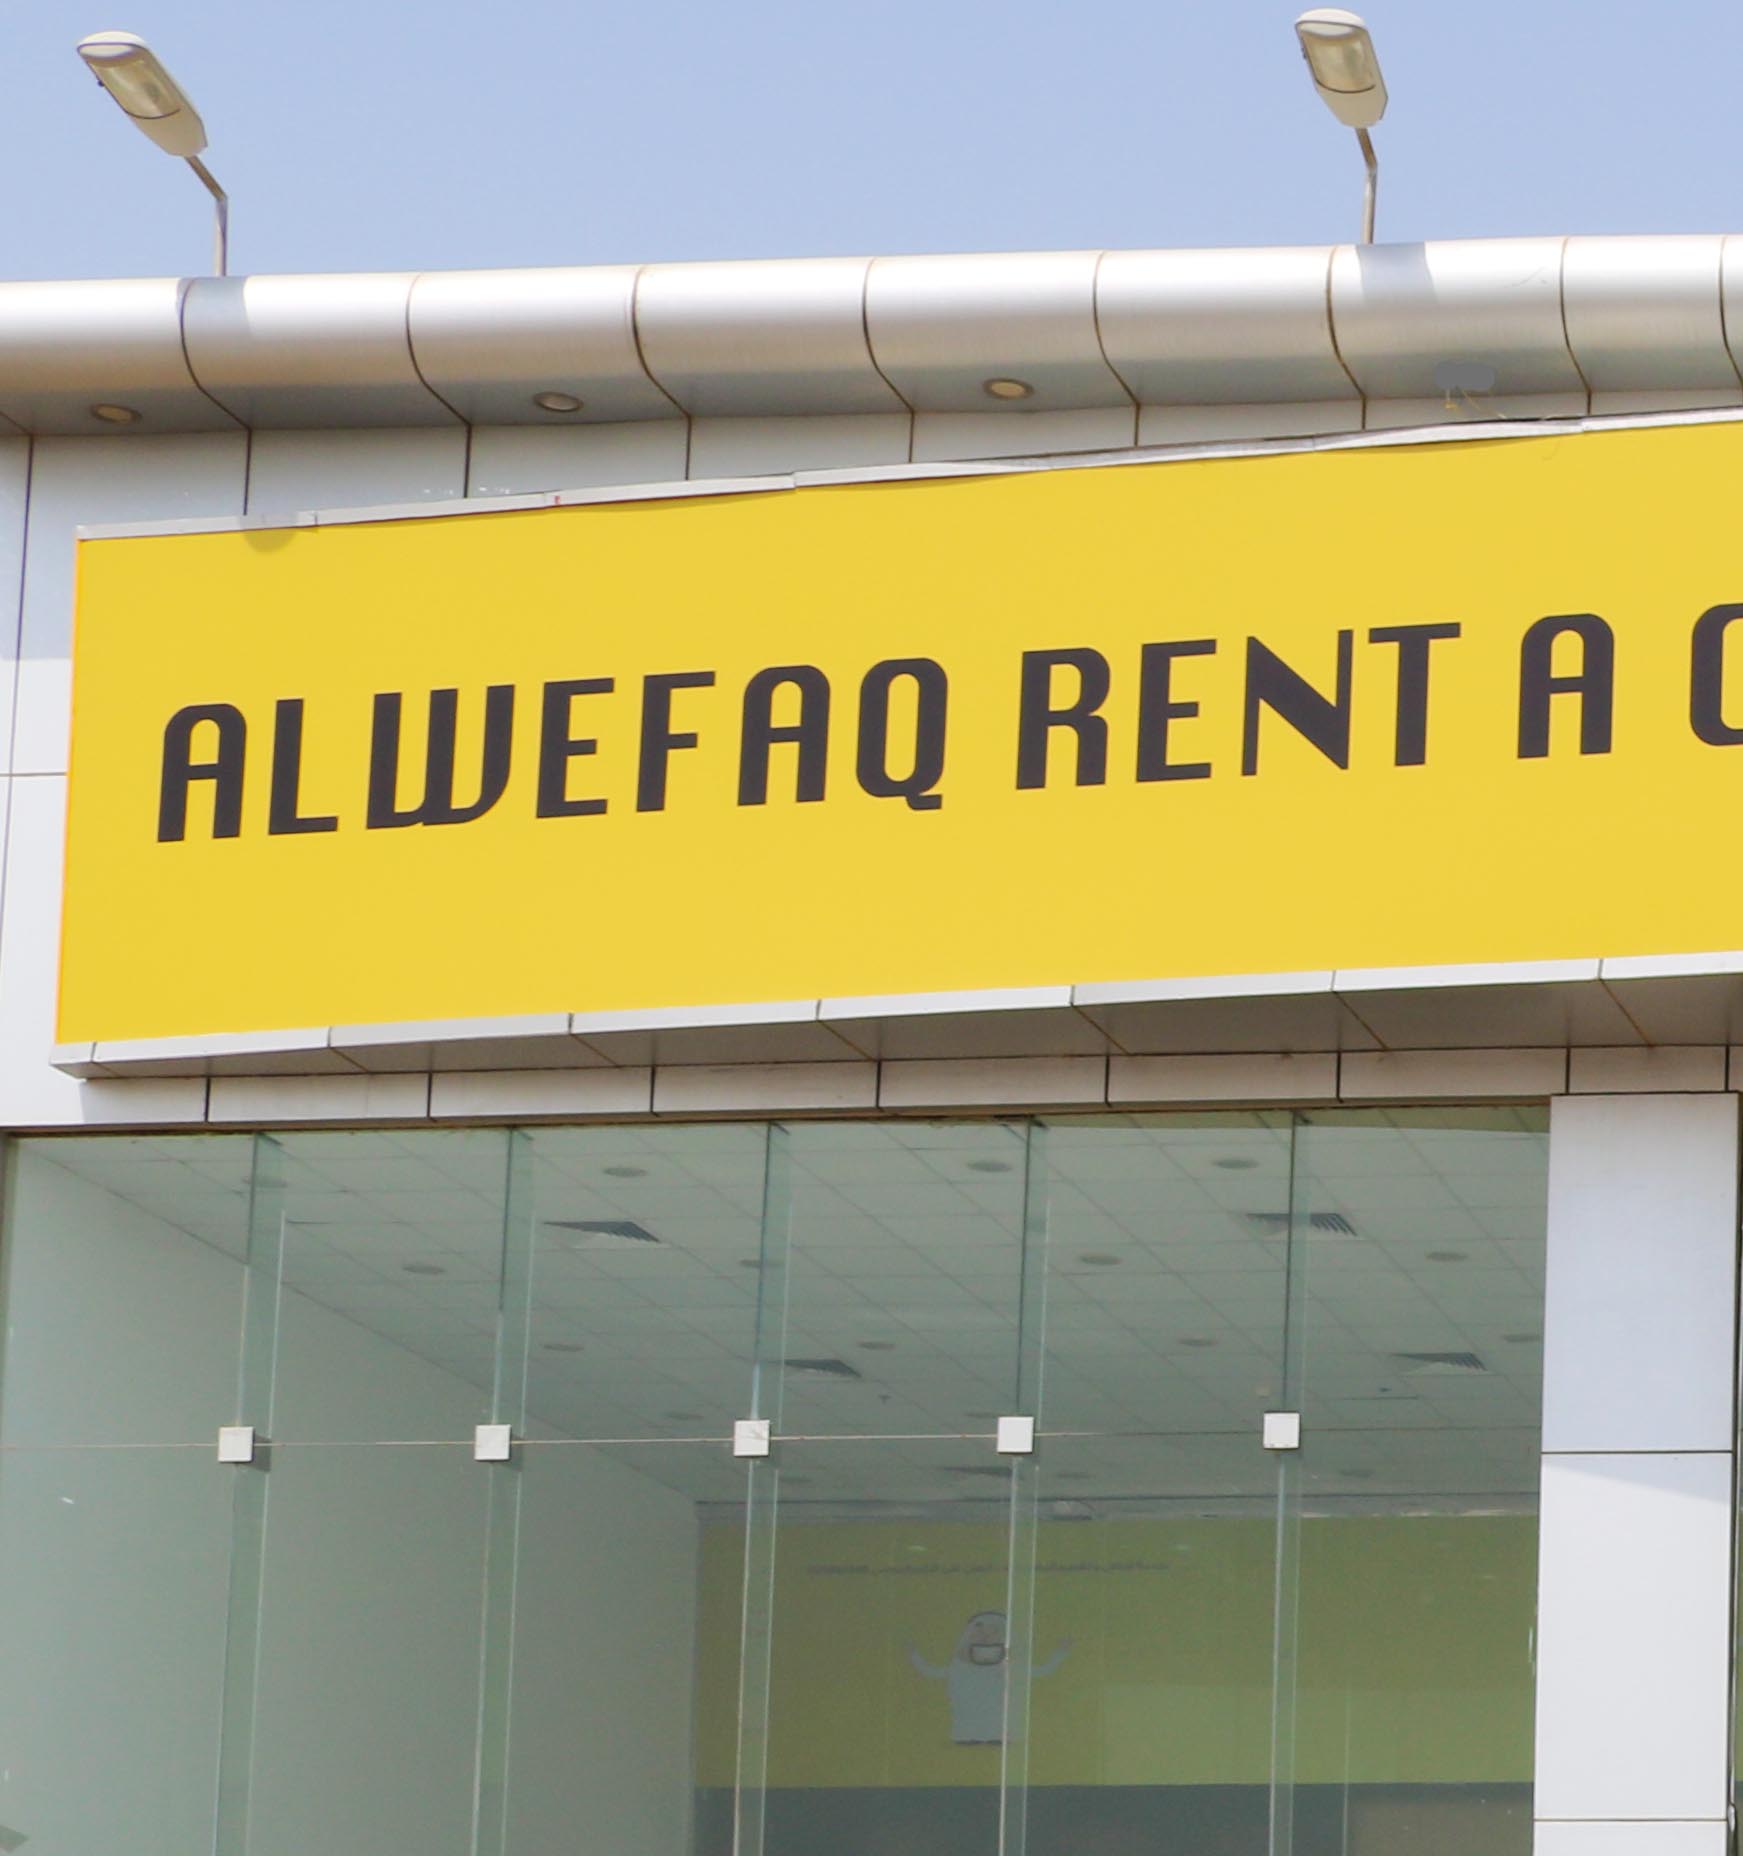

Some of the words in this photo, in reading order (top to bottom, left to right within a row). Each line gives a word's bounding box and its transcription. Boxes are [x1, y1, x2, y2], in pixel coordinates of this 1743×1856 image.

[156, 656, 949, 844] ALWEFAQ
[1015, 621, 1462, 791] RENT
[1516, 612, 1615, 760] A
